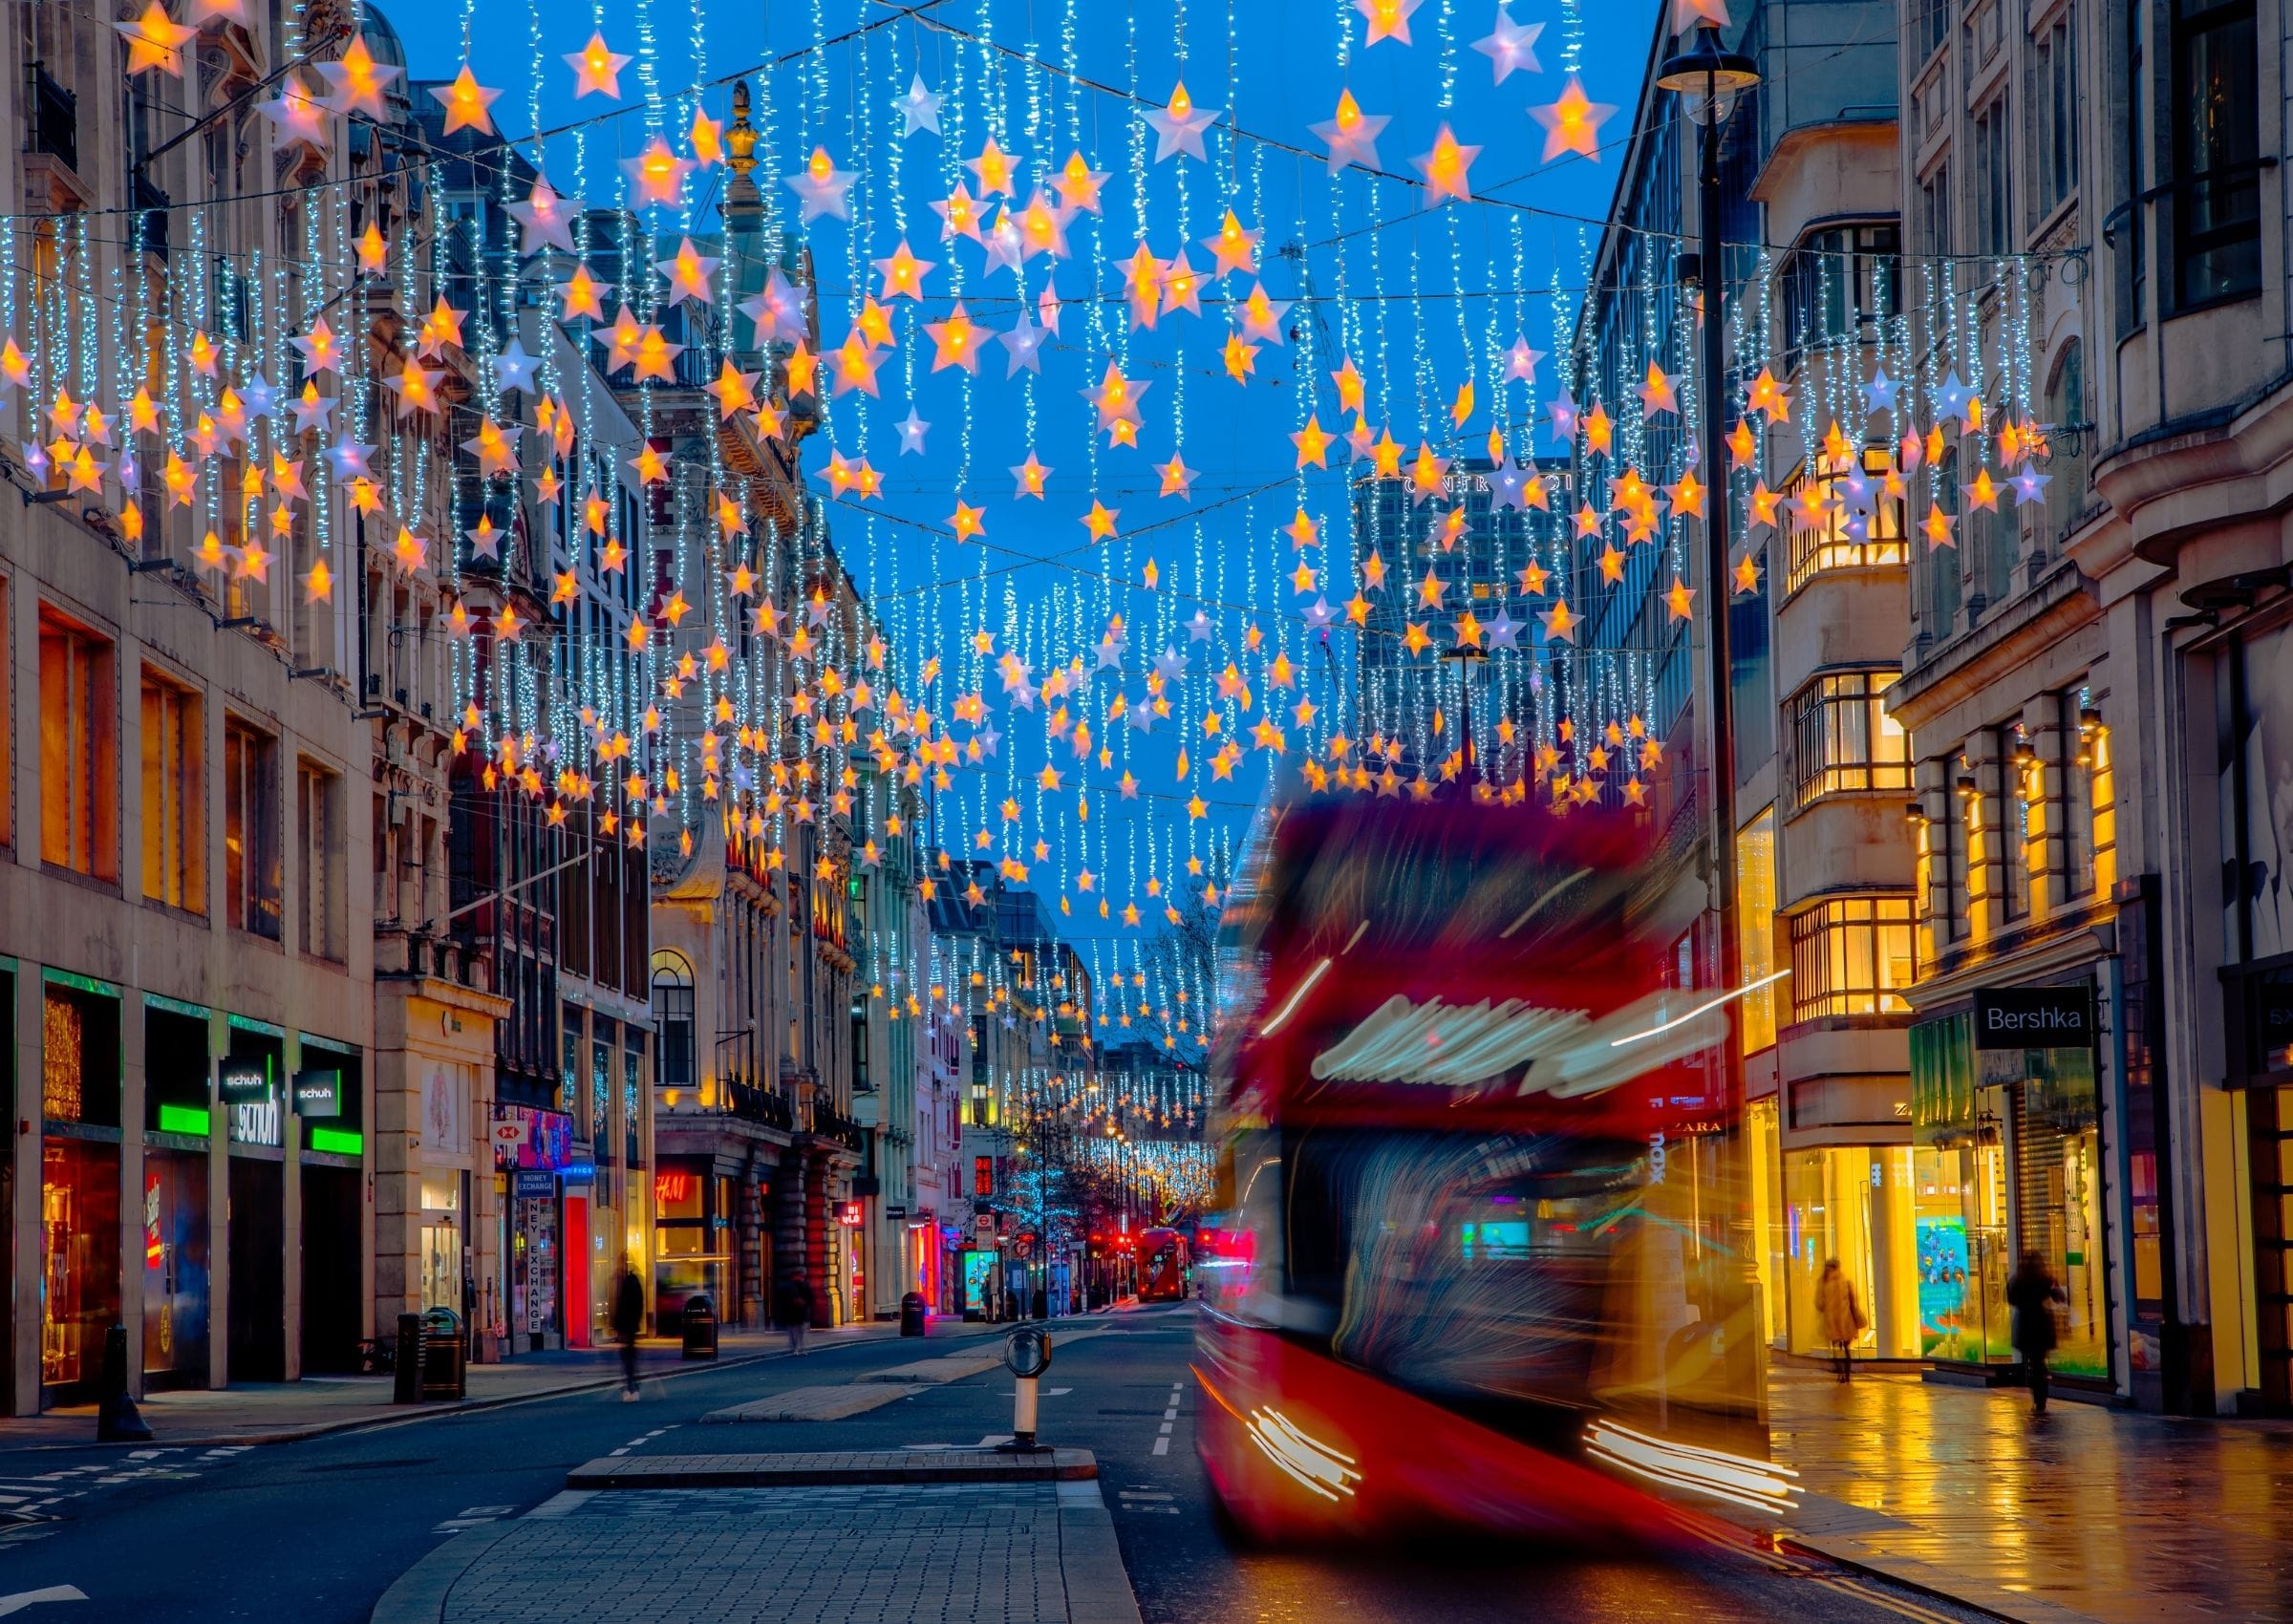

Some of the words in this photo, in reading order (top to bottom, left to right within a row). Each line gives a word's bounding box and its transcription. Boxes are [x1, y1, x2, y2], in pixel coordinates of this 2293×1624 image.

[1987, 1007, 2083, 1030] Bershka
[226, 1074, 263, 1086] schuh
[299, 1088, 332, 1099] schuh
[1672, 1122, 1724, 1132] ZARA
[524, 1174, 547, 1183] MONEY
[518, 1183, 553, 1191] EXCHANGE
[530, 1245, 540, 1330] EXCHANGE
